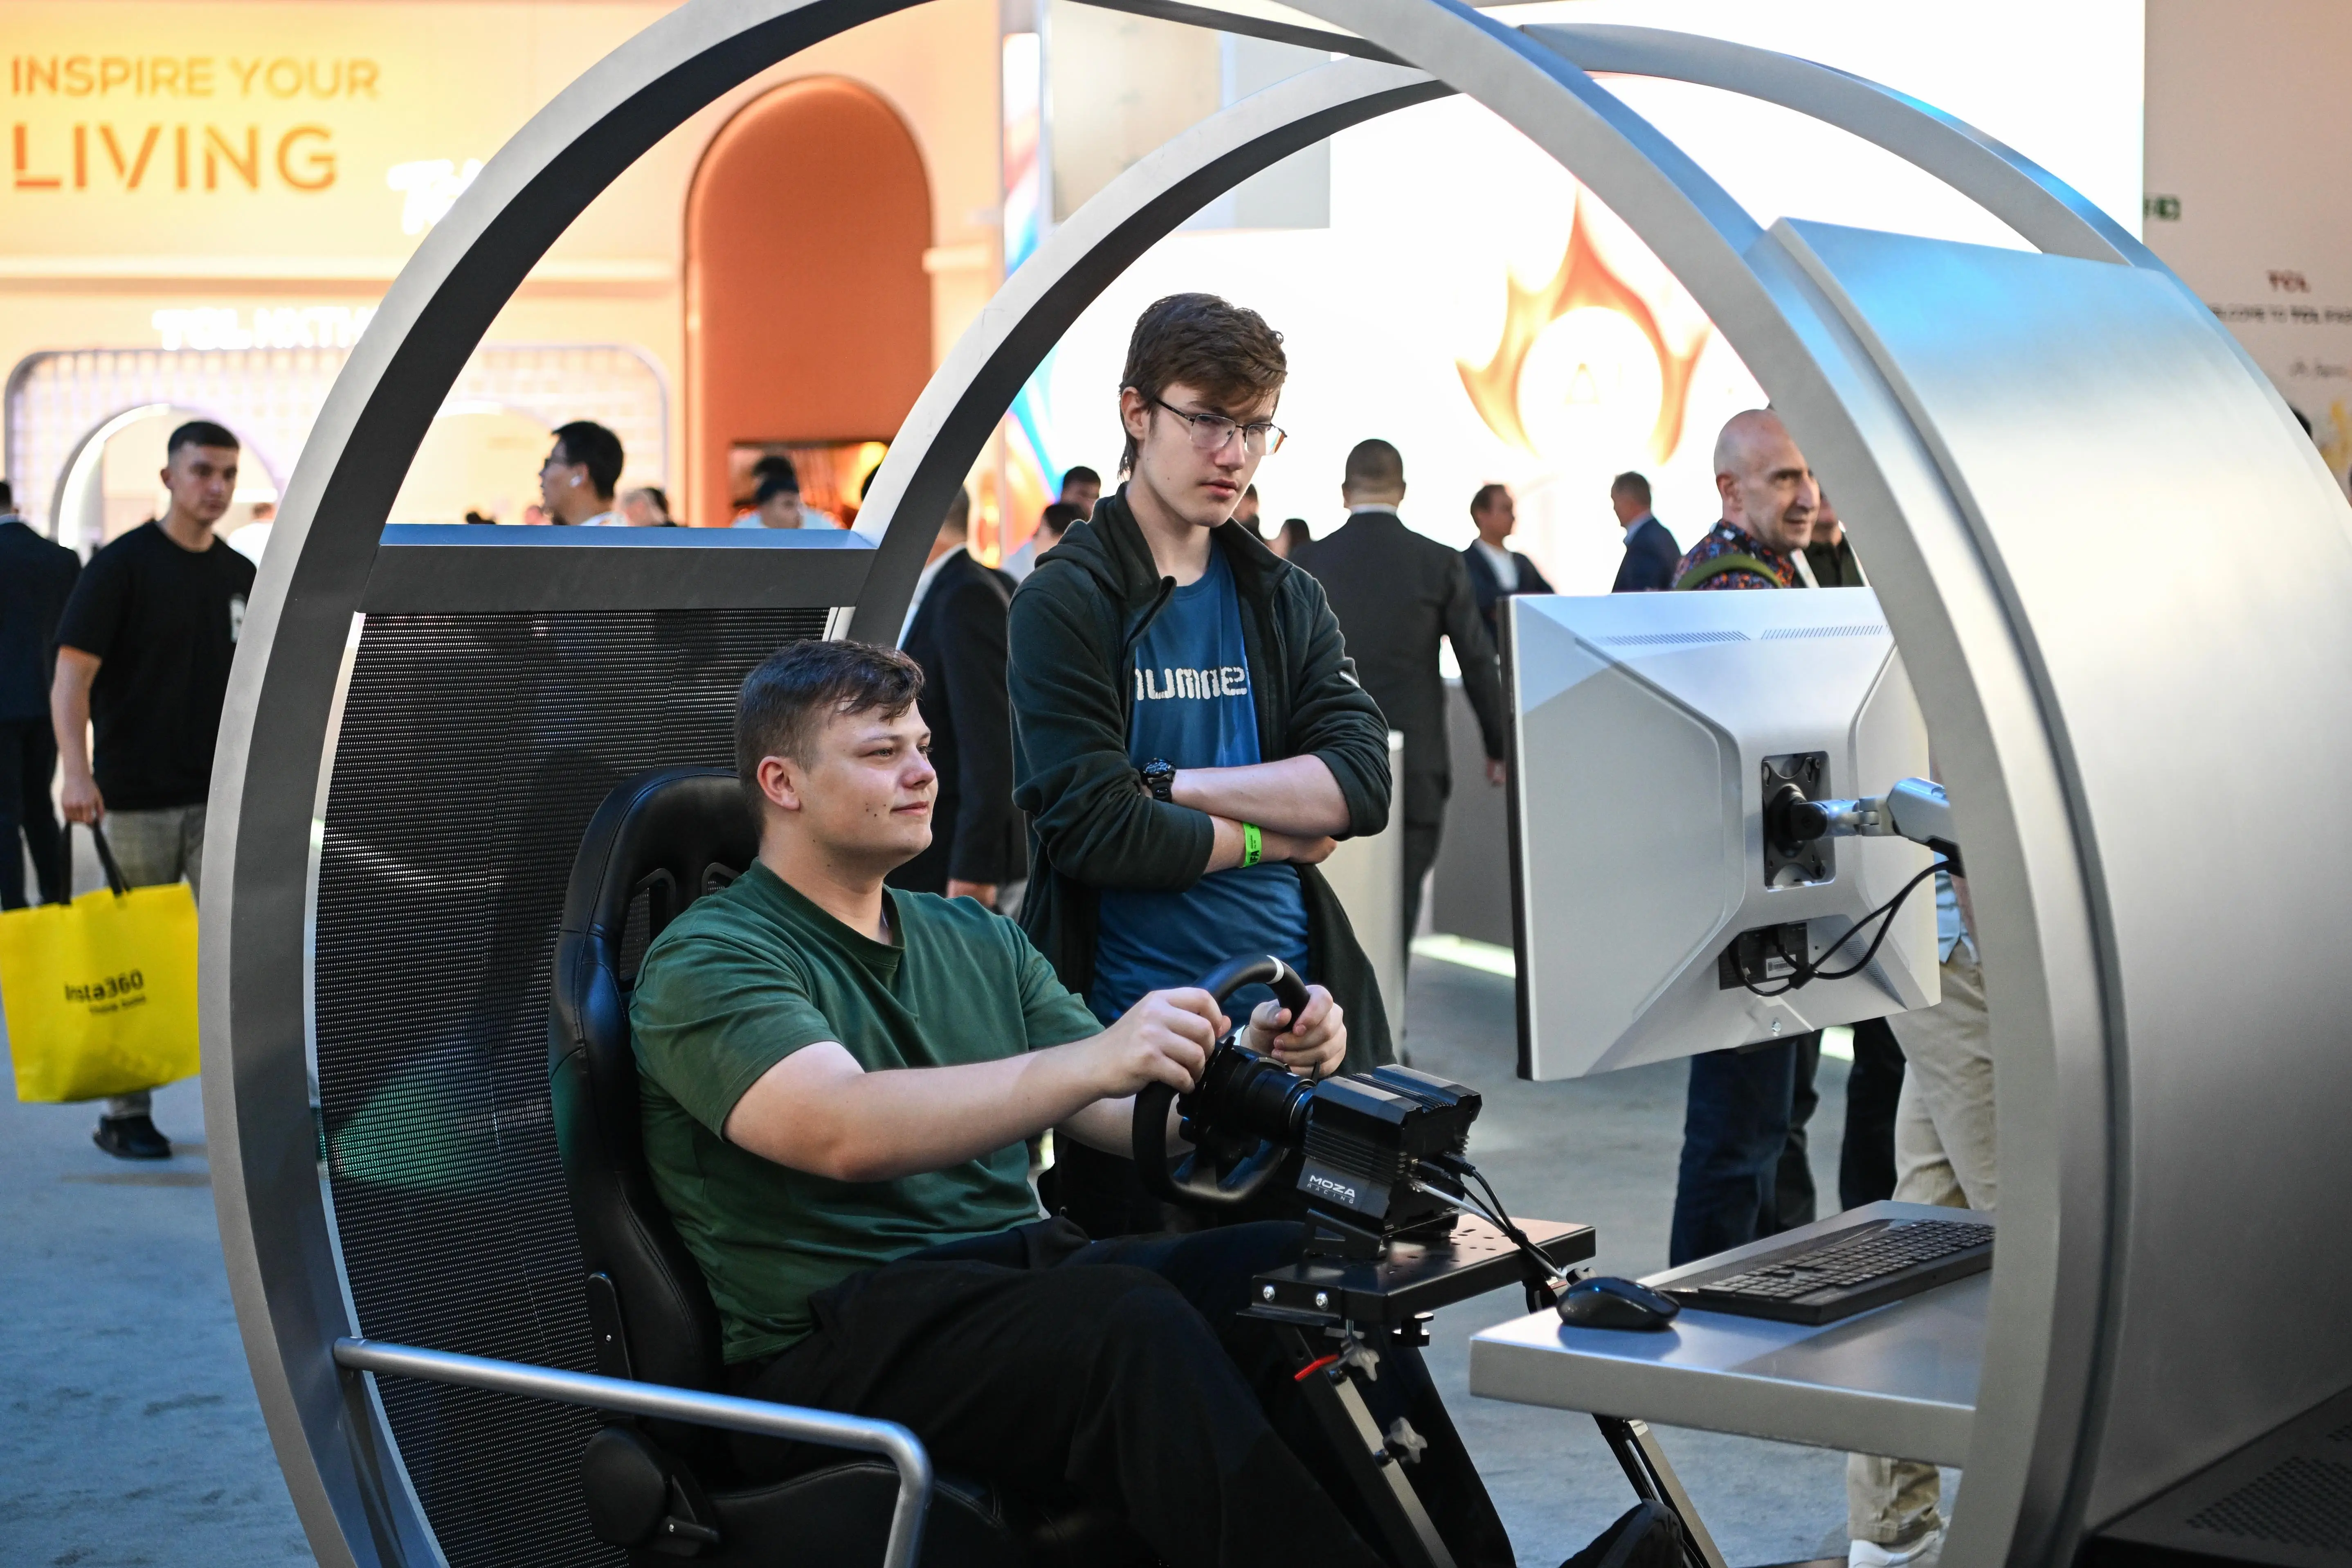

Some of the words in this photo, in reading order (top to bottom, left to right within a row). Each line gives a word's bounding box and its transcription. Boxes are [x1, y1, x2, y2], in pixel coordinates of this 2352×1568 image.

[11, 54, 216, 98] INSPIRE
[227, 56, 382, 101] YOUR
[13, 122, 339, 192] LIVING
[63, 970, 144, 1002] Insta360
[1307, 1183, 1354, 1204] RACING
[1309, 1174, 1355, 1198] MOZA
